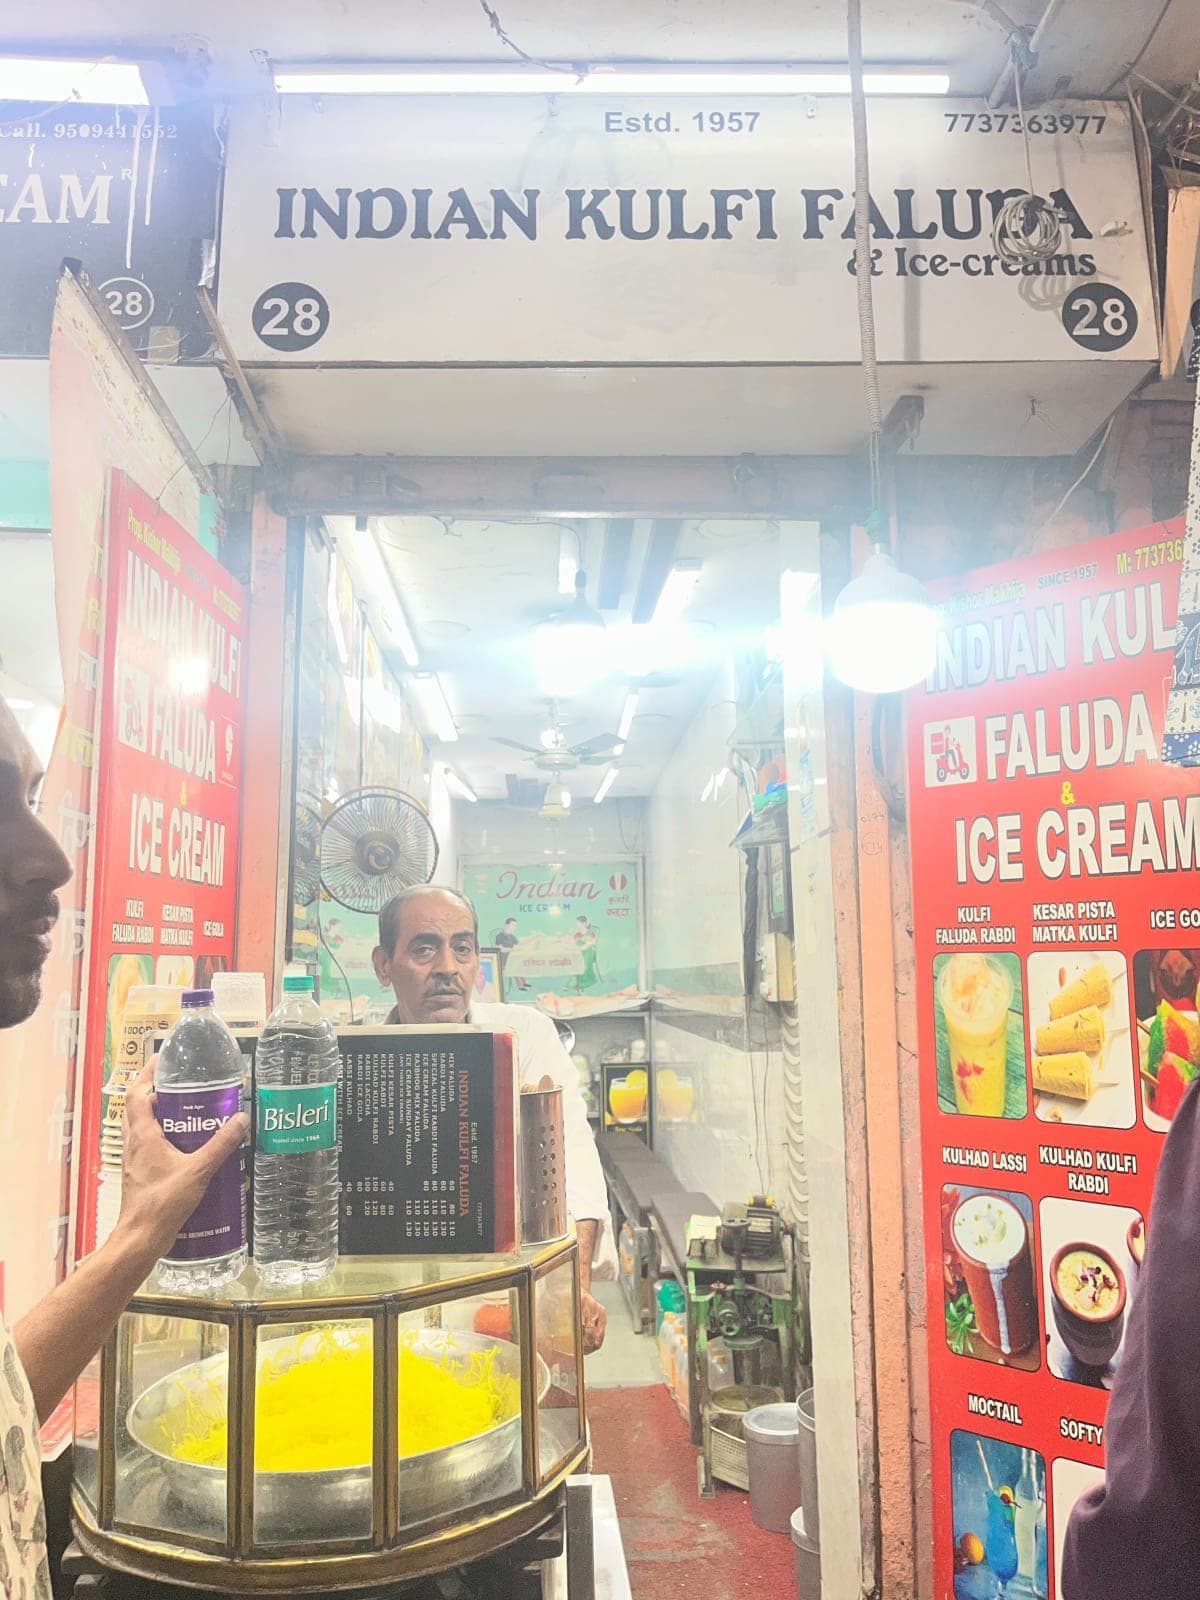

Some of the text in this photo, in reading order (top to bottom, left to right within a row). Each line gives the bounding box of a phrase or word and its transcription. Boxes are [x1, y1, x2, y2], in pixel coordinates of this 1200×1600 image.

[605, 112, 760, 132] Estd. 1957
[944, 113, 1106, 134] 7737363977
[273, 187, 540, 241] INDIAN
[564, 187, 778, 241] KULFI
[105, 291, 143, 315] 28
[260, 297, 321, 336] 28
[1070, 298, 1129, 336] 28
[1038, 570, 1070, 590] SINCE
[1073, 564, 1099, 581] 1957
[124, 548, 195, 655] INDIAN
[151, 684, 217, 784] FALUDA
[984, 692, 1159, 782] FALUDA
[1061, 781, 1076, 805] &
[128, 791, 226, 888] ICE CREAM
[955, 794, 1200, 884] ICE CREAM
[496, 871, 602, 901] Indian
[957, 905, 991, 923] KULFI
[1032, 900, 1115, 921] KESAR PISTA
[1151, 910, 1175, 929] ICE
[936, 926, 1016, 944] FALUDA RABDI
[1032, 924, 1118, 943] MATKA KULFI
[264, 1100, 329, 1131] Bisleri
[459, 1070, 468, 1216] INDIAN KULFI FALUDA
[942, 1145, 1027, 1173] KULHAD LASSI
[1040, 1145, 1137, 1174] KULHAD KULFI
[1068, 1173, 1109, 1194] RABDI
[968, 1394, 1022, 1424] MOCTAIL
[1060, 1418, 1103, 1445] SOFTY
